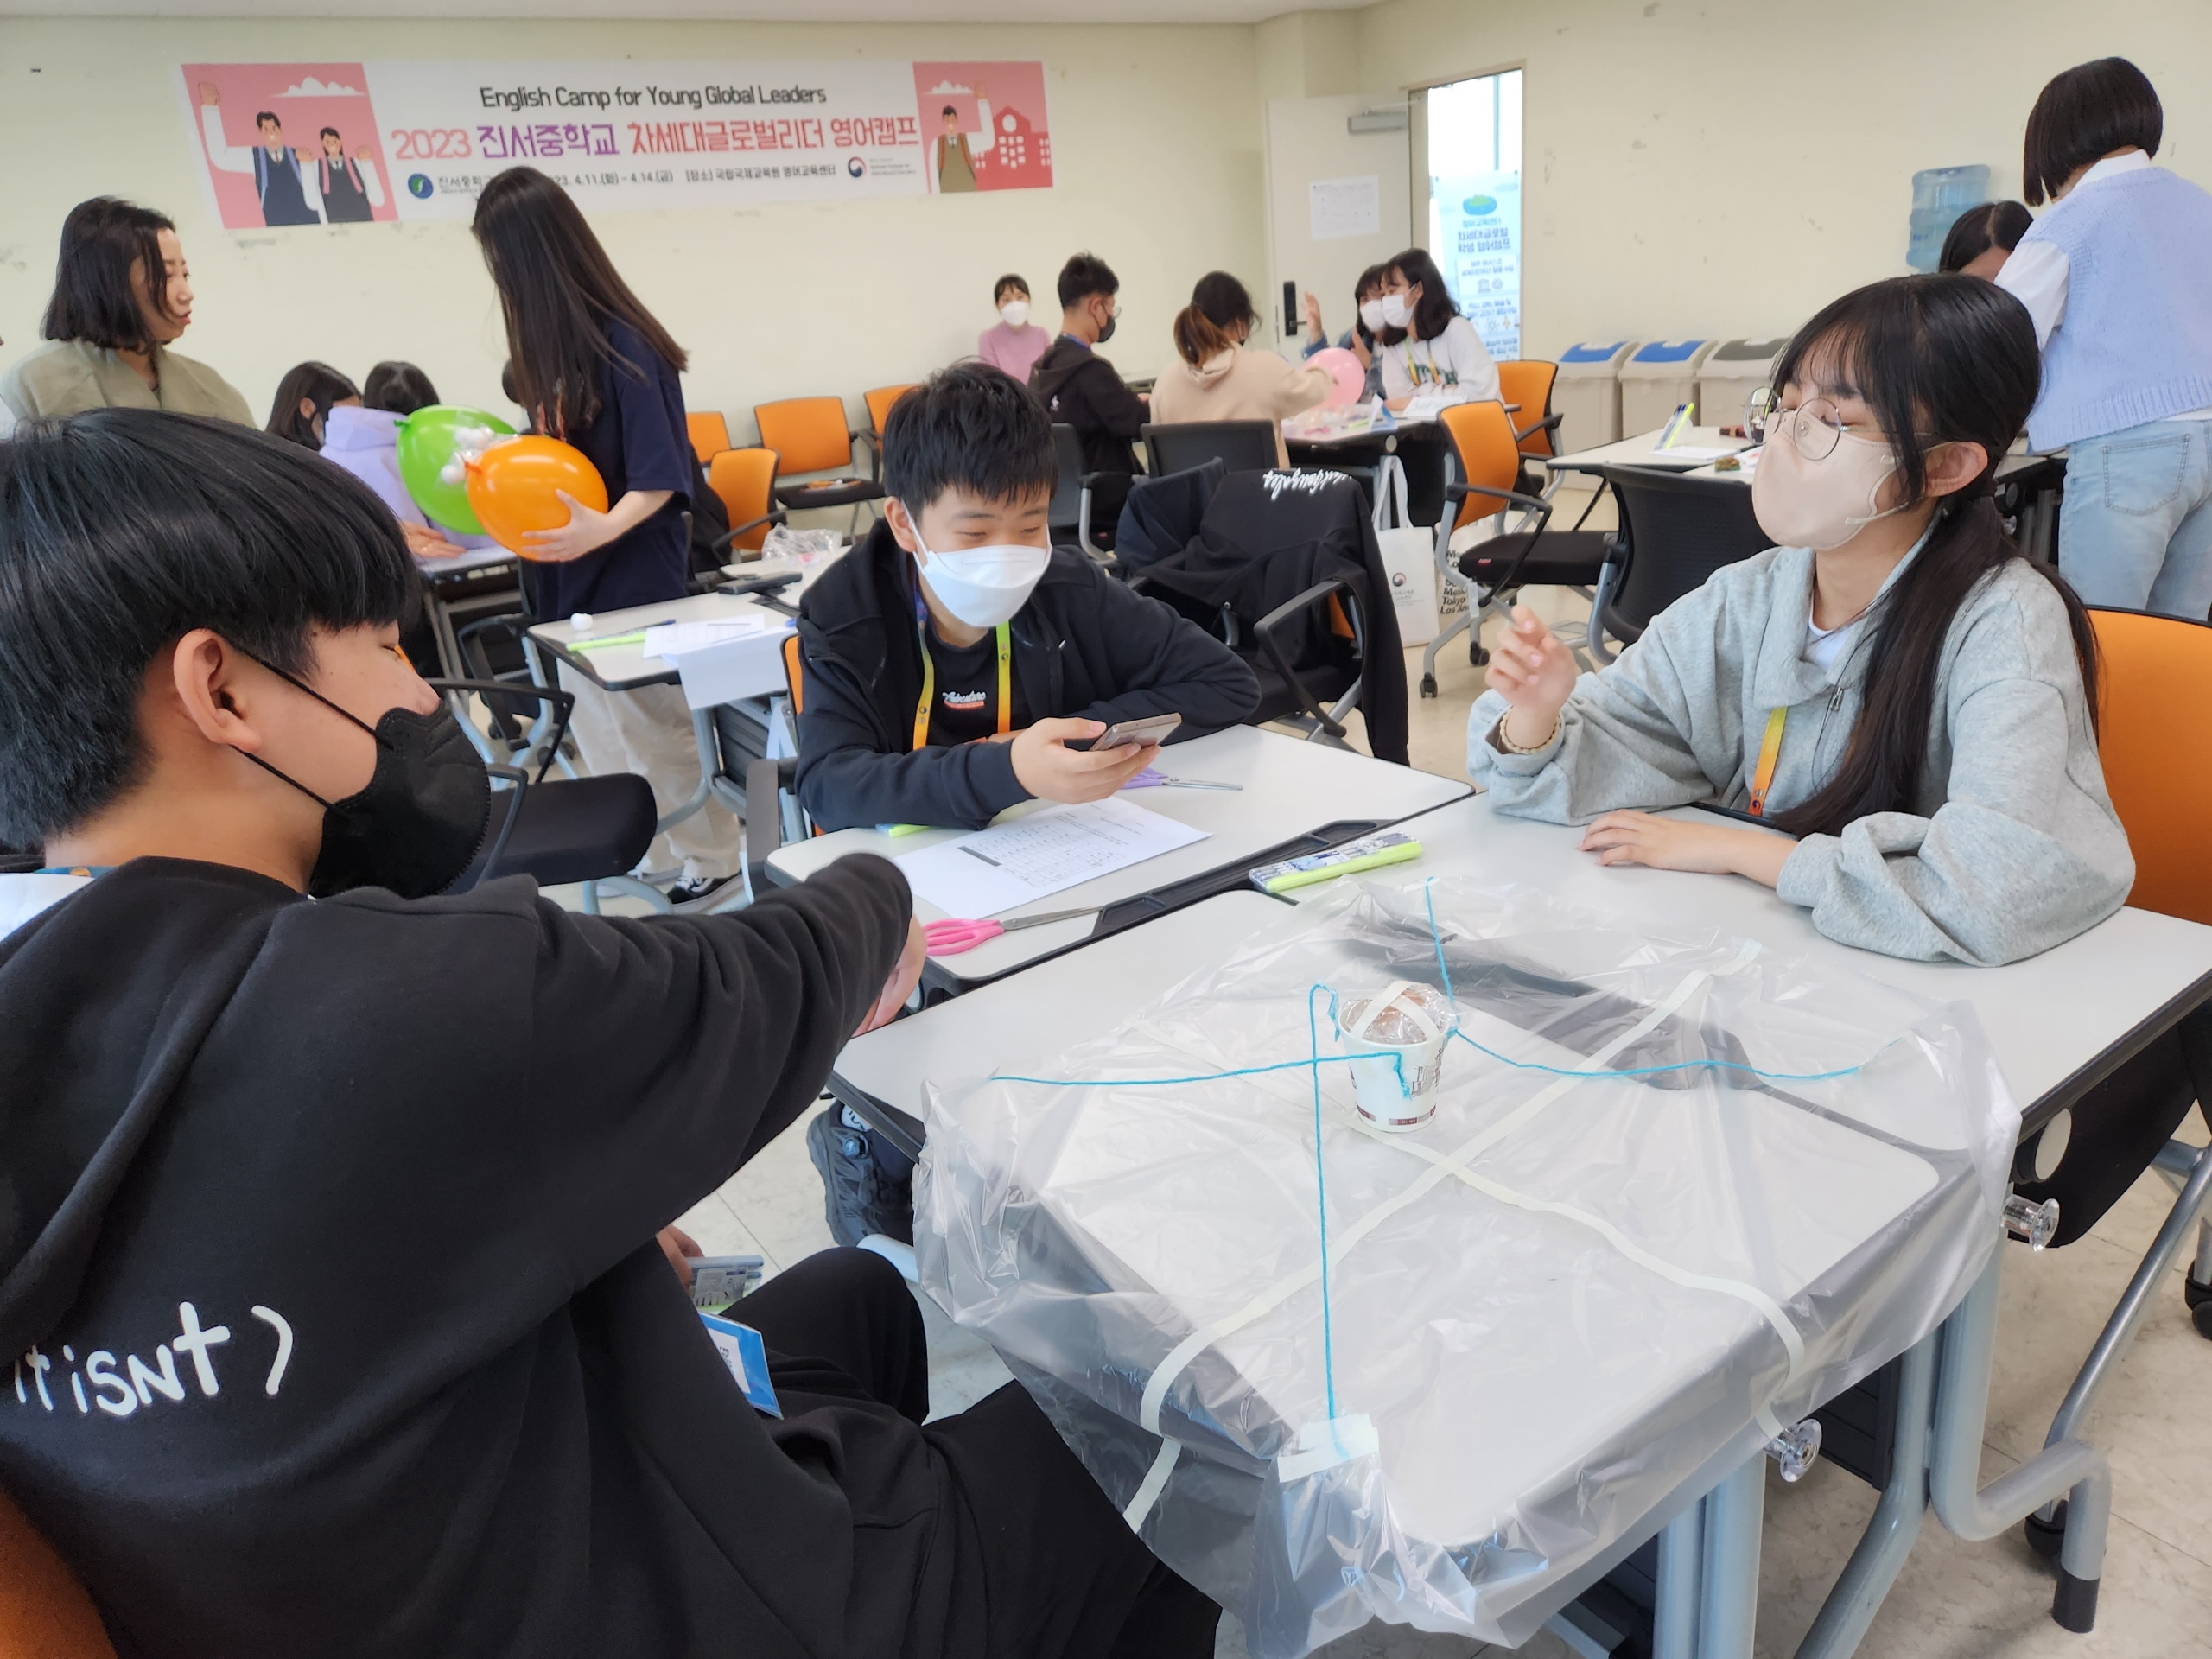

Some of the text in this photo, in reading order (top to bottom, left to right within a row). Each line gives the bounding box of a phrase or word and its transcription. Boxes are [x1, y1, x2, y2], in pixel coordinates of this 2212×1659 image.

[480, 84, 827, 111] English Camp for Young Global Leaders
[391, 116, 919, 160] 2023 진서중학교 차세대글로벌리더 영어캠프
